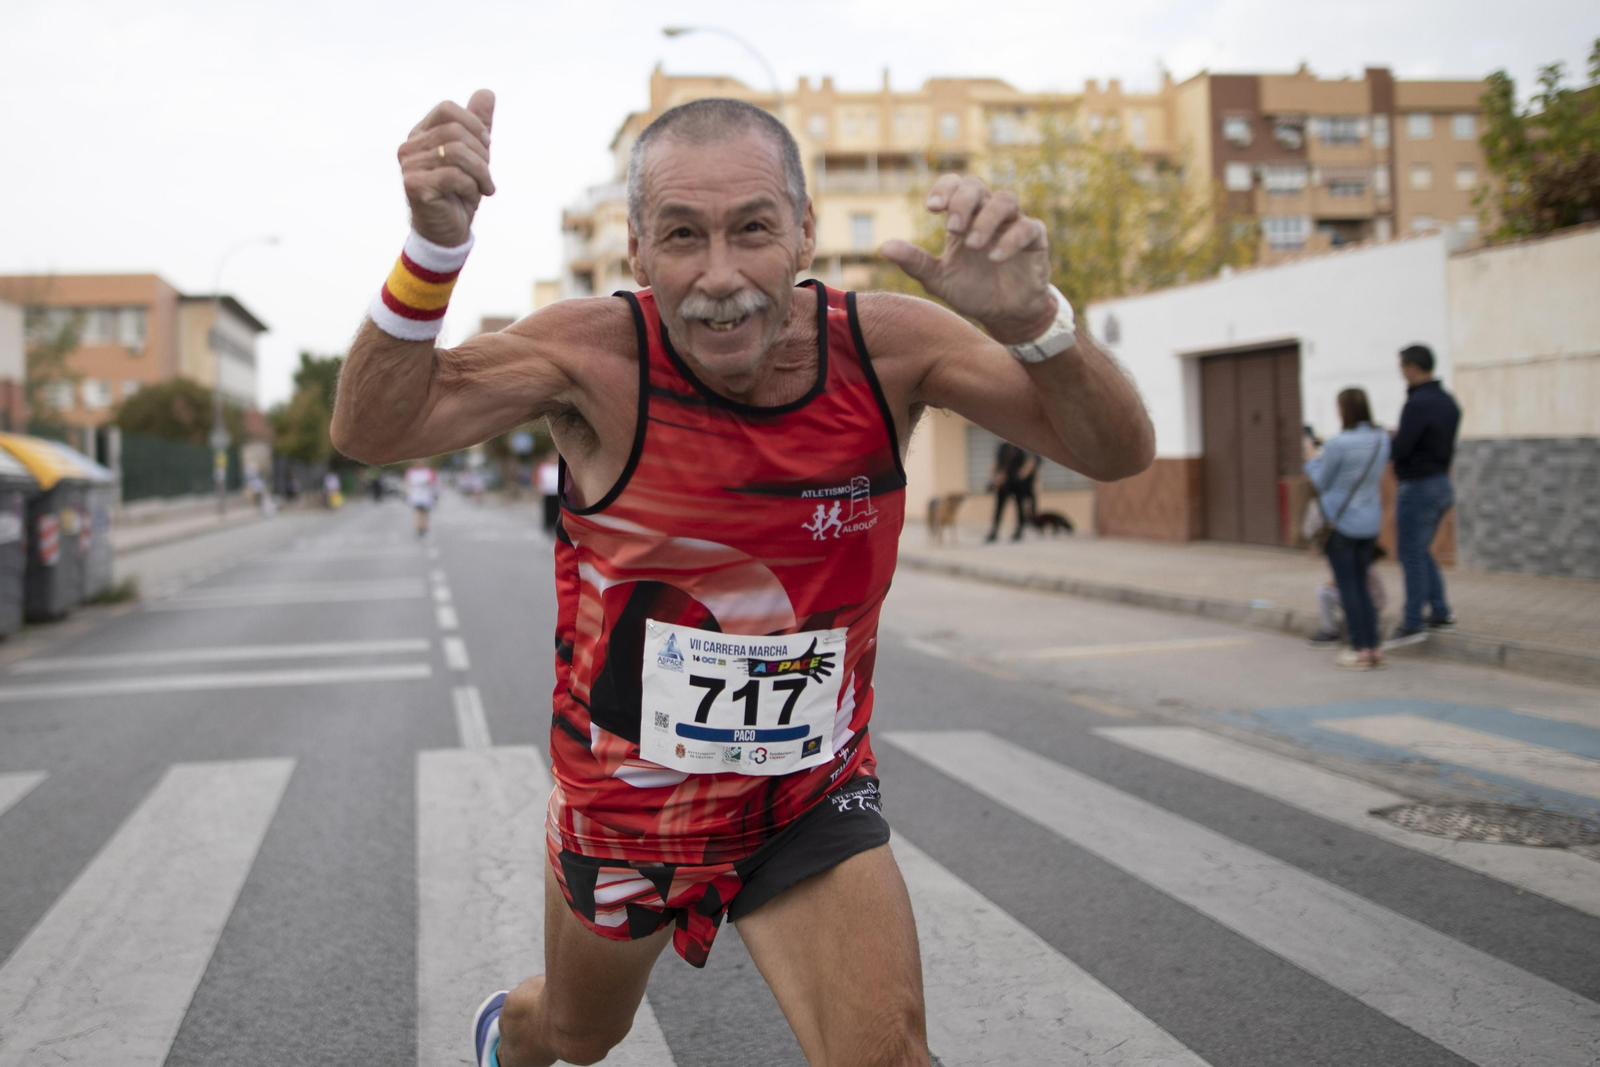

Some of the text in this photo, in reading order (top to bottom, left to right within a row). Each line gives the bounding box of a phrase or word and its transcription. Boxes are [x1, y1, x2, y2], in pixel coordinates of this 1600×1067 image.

[801, 485, 851, 498] ATLETISMO
[690, 637, 788, 657] VII CARRERA MARCHA
[657, 656, 684, 667] ASPACE
[701, 656, 717, 665] OCT
[753, 656, 821, 673] ASPACE
[689, 674, 808, 726] 717
[733, 729, 756, 742] PACO
